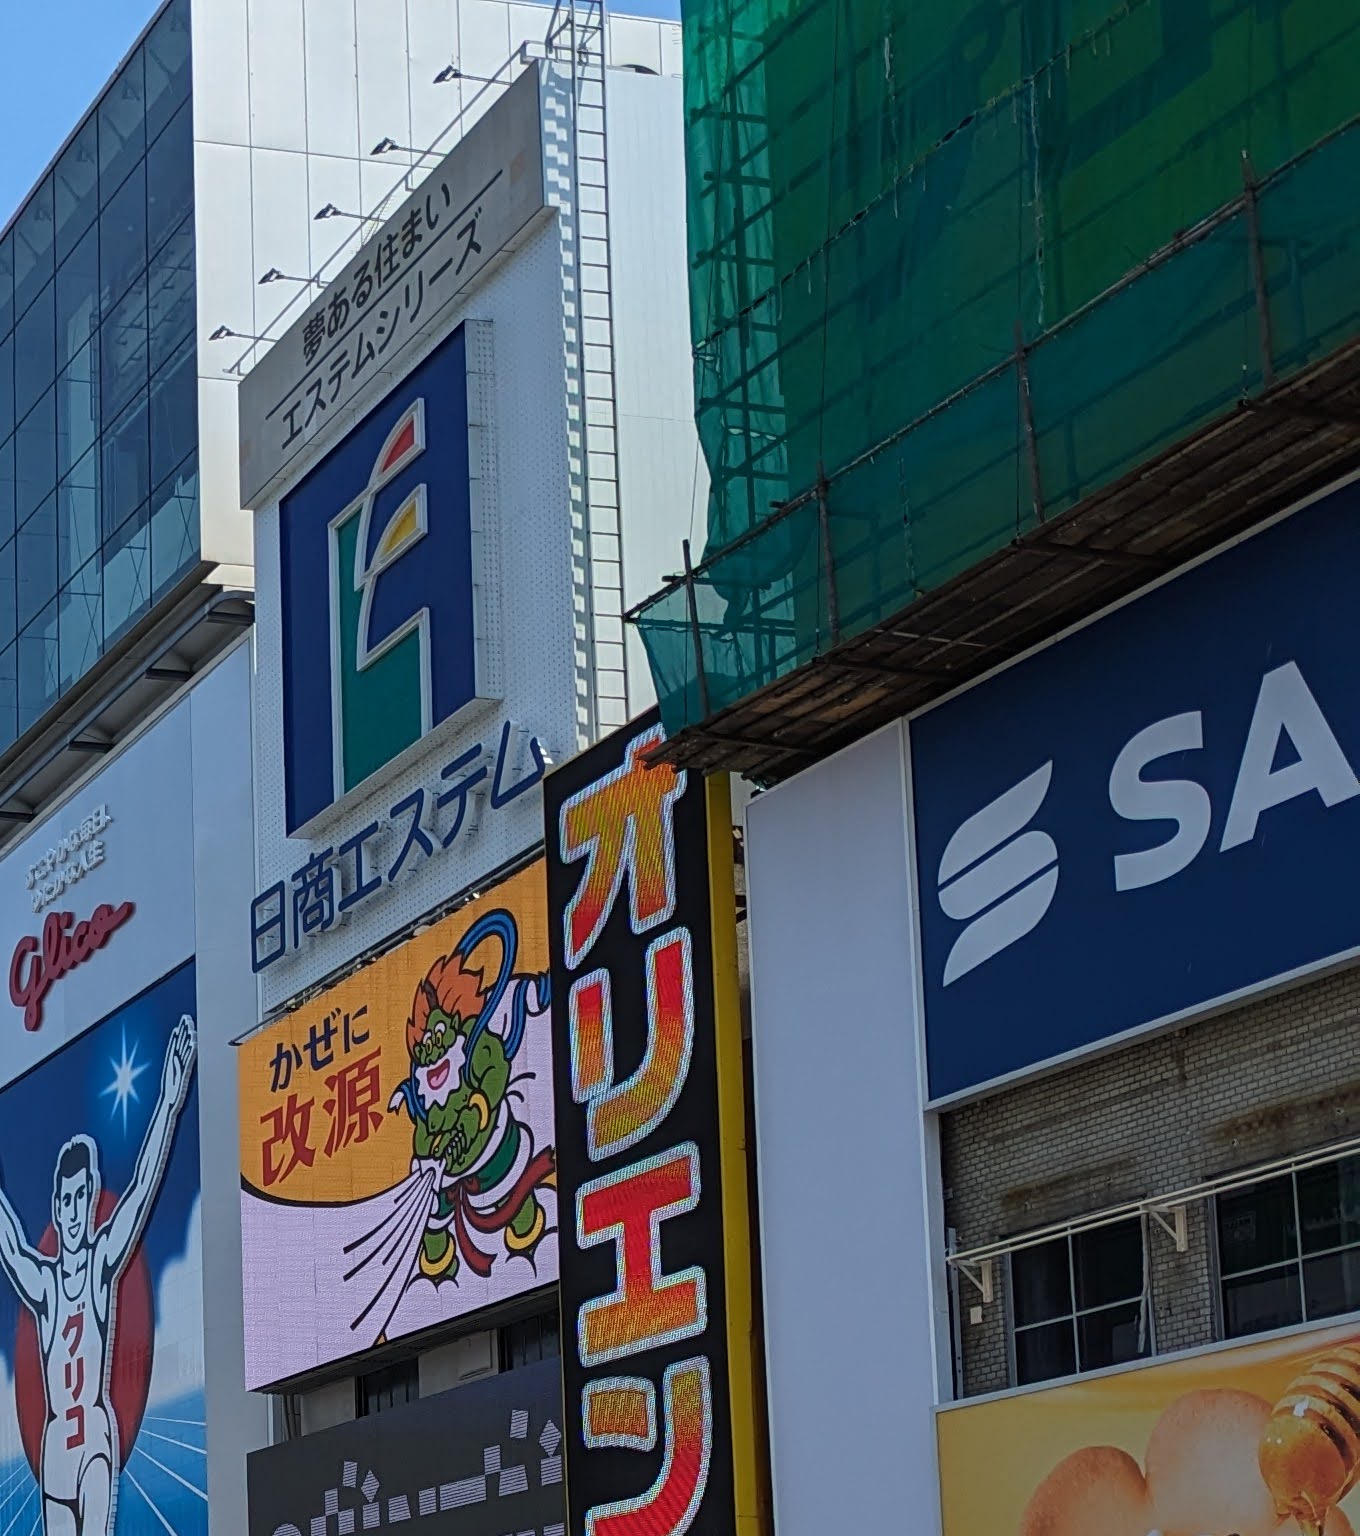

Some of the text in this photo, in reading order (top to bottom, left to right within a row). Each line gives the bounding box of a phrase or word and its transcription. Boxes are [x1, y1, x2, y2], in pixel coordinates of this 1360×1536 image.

[282, 205, 486, 450] エステムシリーズ
[302, 182, 453, 363] 夢ある住まい
[249, 719, 548, 974] 日商エステム
[1108, 660, 1360, 893] SA
[9, 901, 136, 1032] Glico
[260, 1045, 384, 1188] 改源
[269, 1004, 371, 1094] かぜに
[61, 1304, 86, 1451] グリコ
